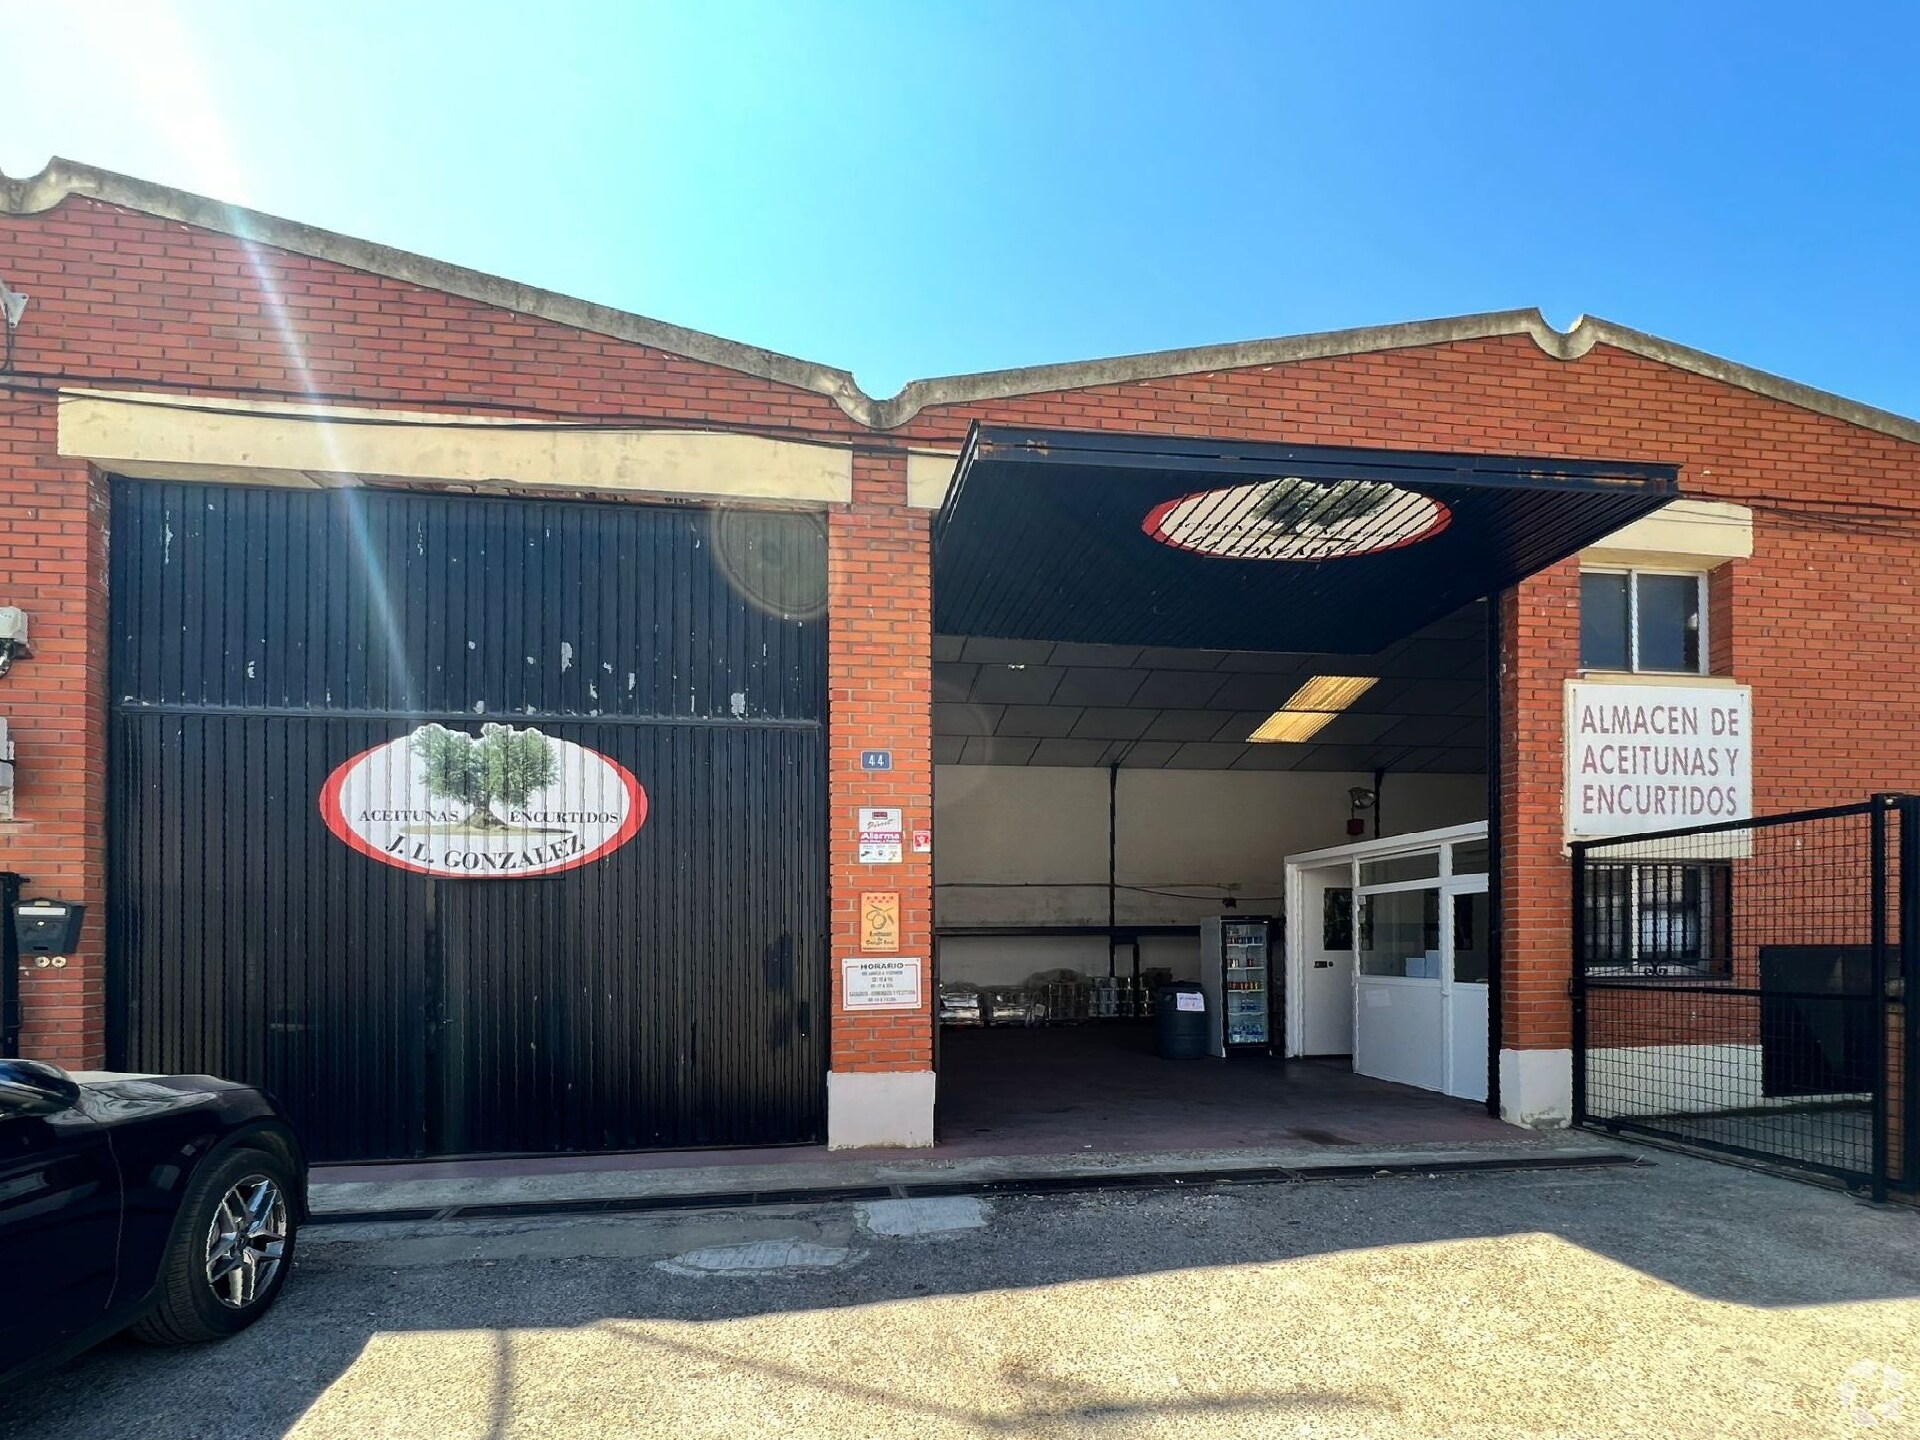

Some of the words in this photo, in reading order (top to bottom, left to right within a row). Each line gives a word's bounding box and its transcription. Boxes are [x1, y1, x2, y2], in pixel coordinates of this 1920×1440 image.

[1581, 705, 1698, 735] ALMACEN
[1711, 707, 1739, 736] DE
[868, 754, 885, 767] 44
[1581, 745, 1719, 776] ACEITUNAS
[1725, 748, 1739, 776] Y
[1582, 784, 1737, 816] ENCURTIDOS
[359, 810, 459, 822] ACEITUNAS
[509, 811, 619, 824] ENCURTIDOS
[860, 832, 900, 840] Alarma
[385, 834, 406, 854] J.
[413, 842, 435, 863] L.
[444, 834, 586, 870] GONZALEZ
[861, 962, 904, 970] HORARIO
